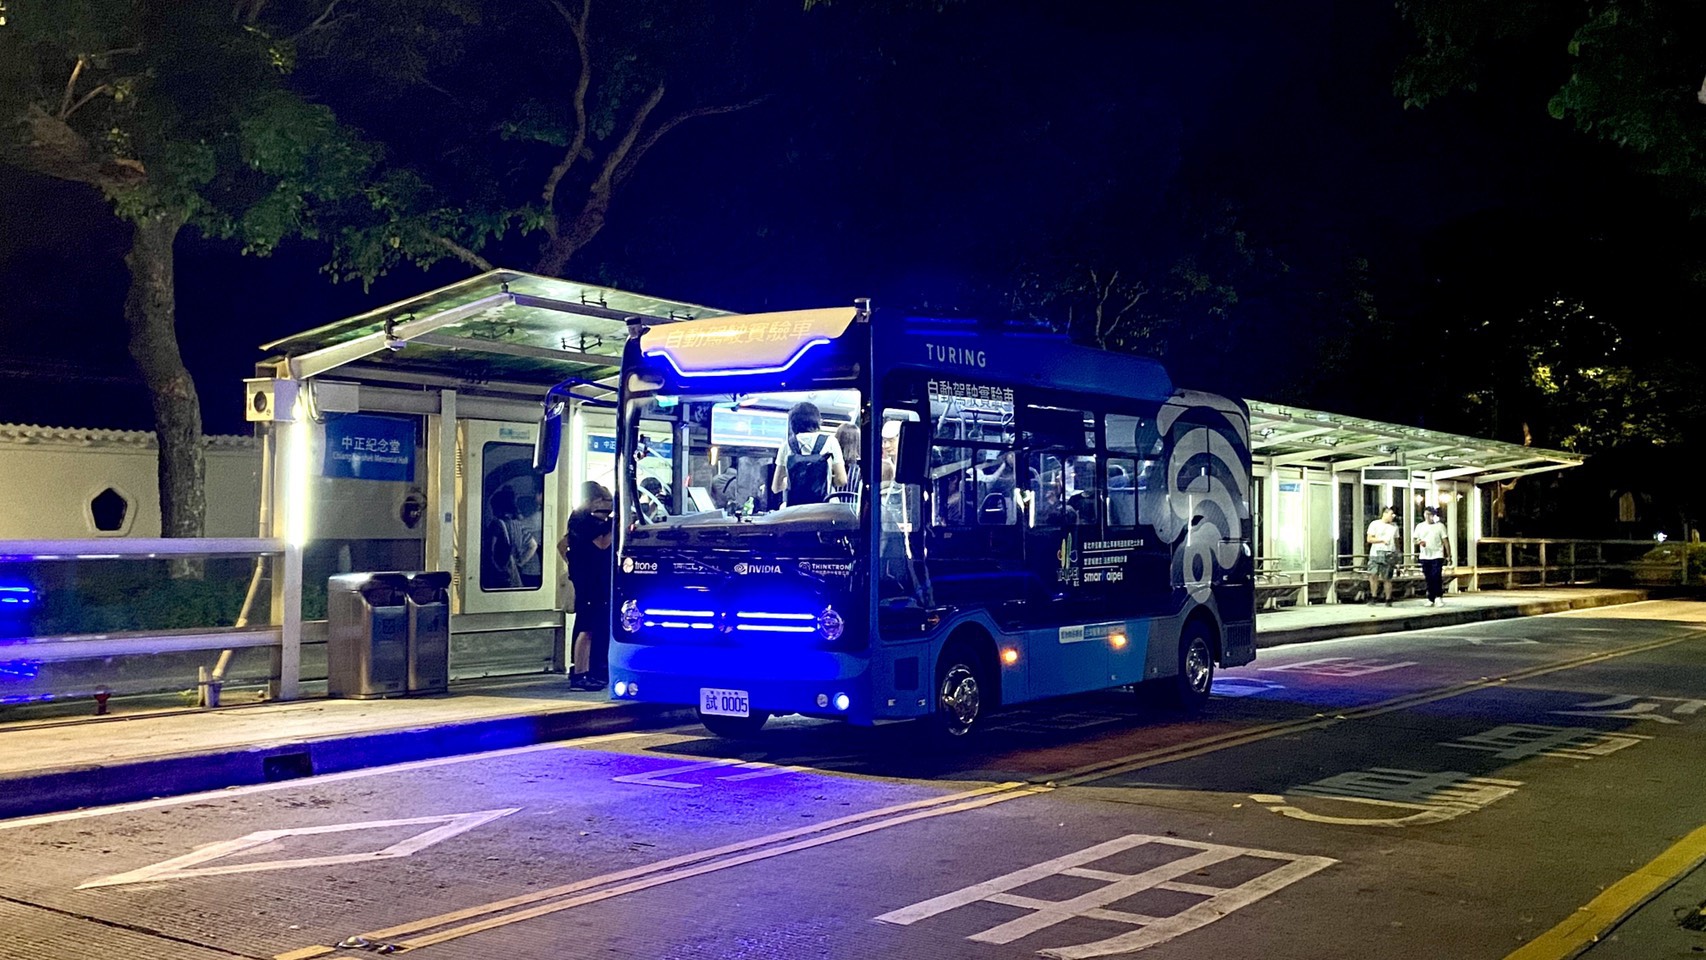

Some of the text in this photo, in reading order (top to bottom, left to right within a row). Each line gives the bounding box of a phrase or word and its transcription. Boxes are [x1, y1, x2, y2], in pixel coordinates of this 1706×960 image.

[664, 318, 816, 350] 自動駕駛實驗車
[926, 343, 987, 368] TURING
[341, 435, 401, 454] 中正紀念堂
[721, 696, 748, 713] 0005
